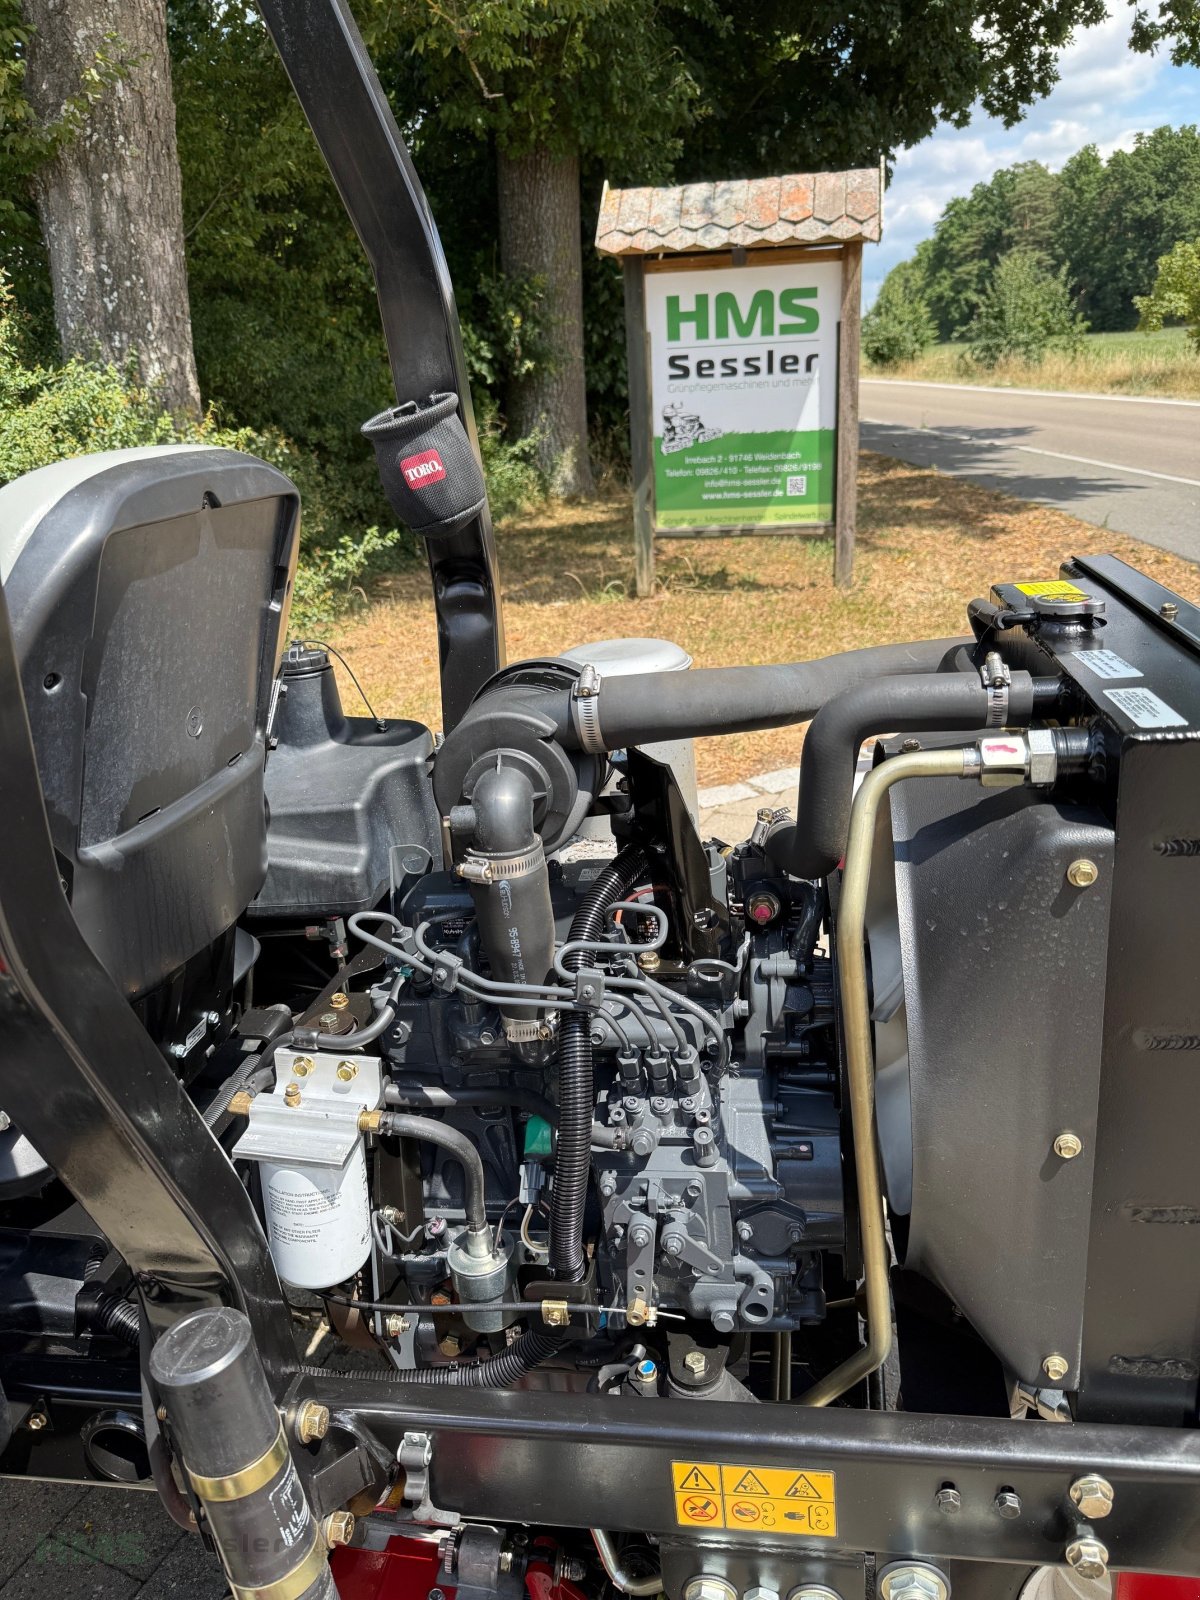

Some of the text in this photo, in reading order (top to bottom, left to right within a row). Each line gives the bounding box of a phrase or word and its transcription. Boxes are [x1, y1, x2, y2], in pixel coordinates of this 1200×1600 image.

[666, 287, 819, 342] HMS
[668, 350, 819, 380] Sessler
[771, 377, 790, 388] und
[405, 460, 440, 481] TORO
[508, 927, 522, 958] 95-8947
